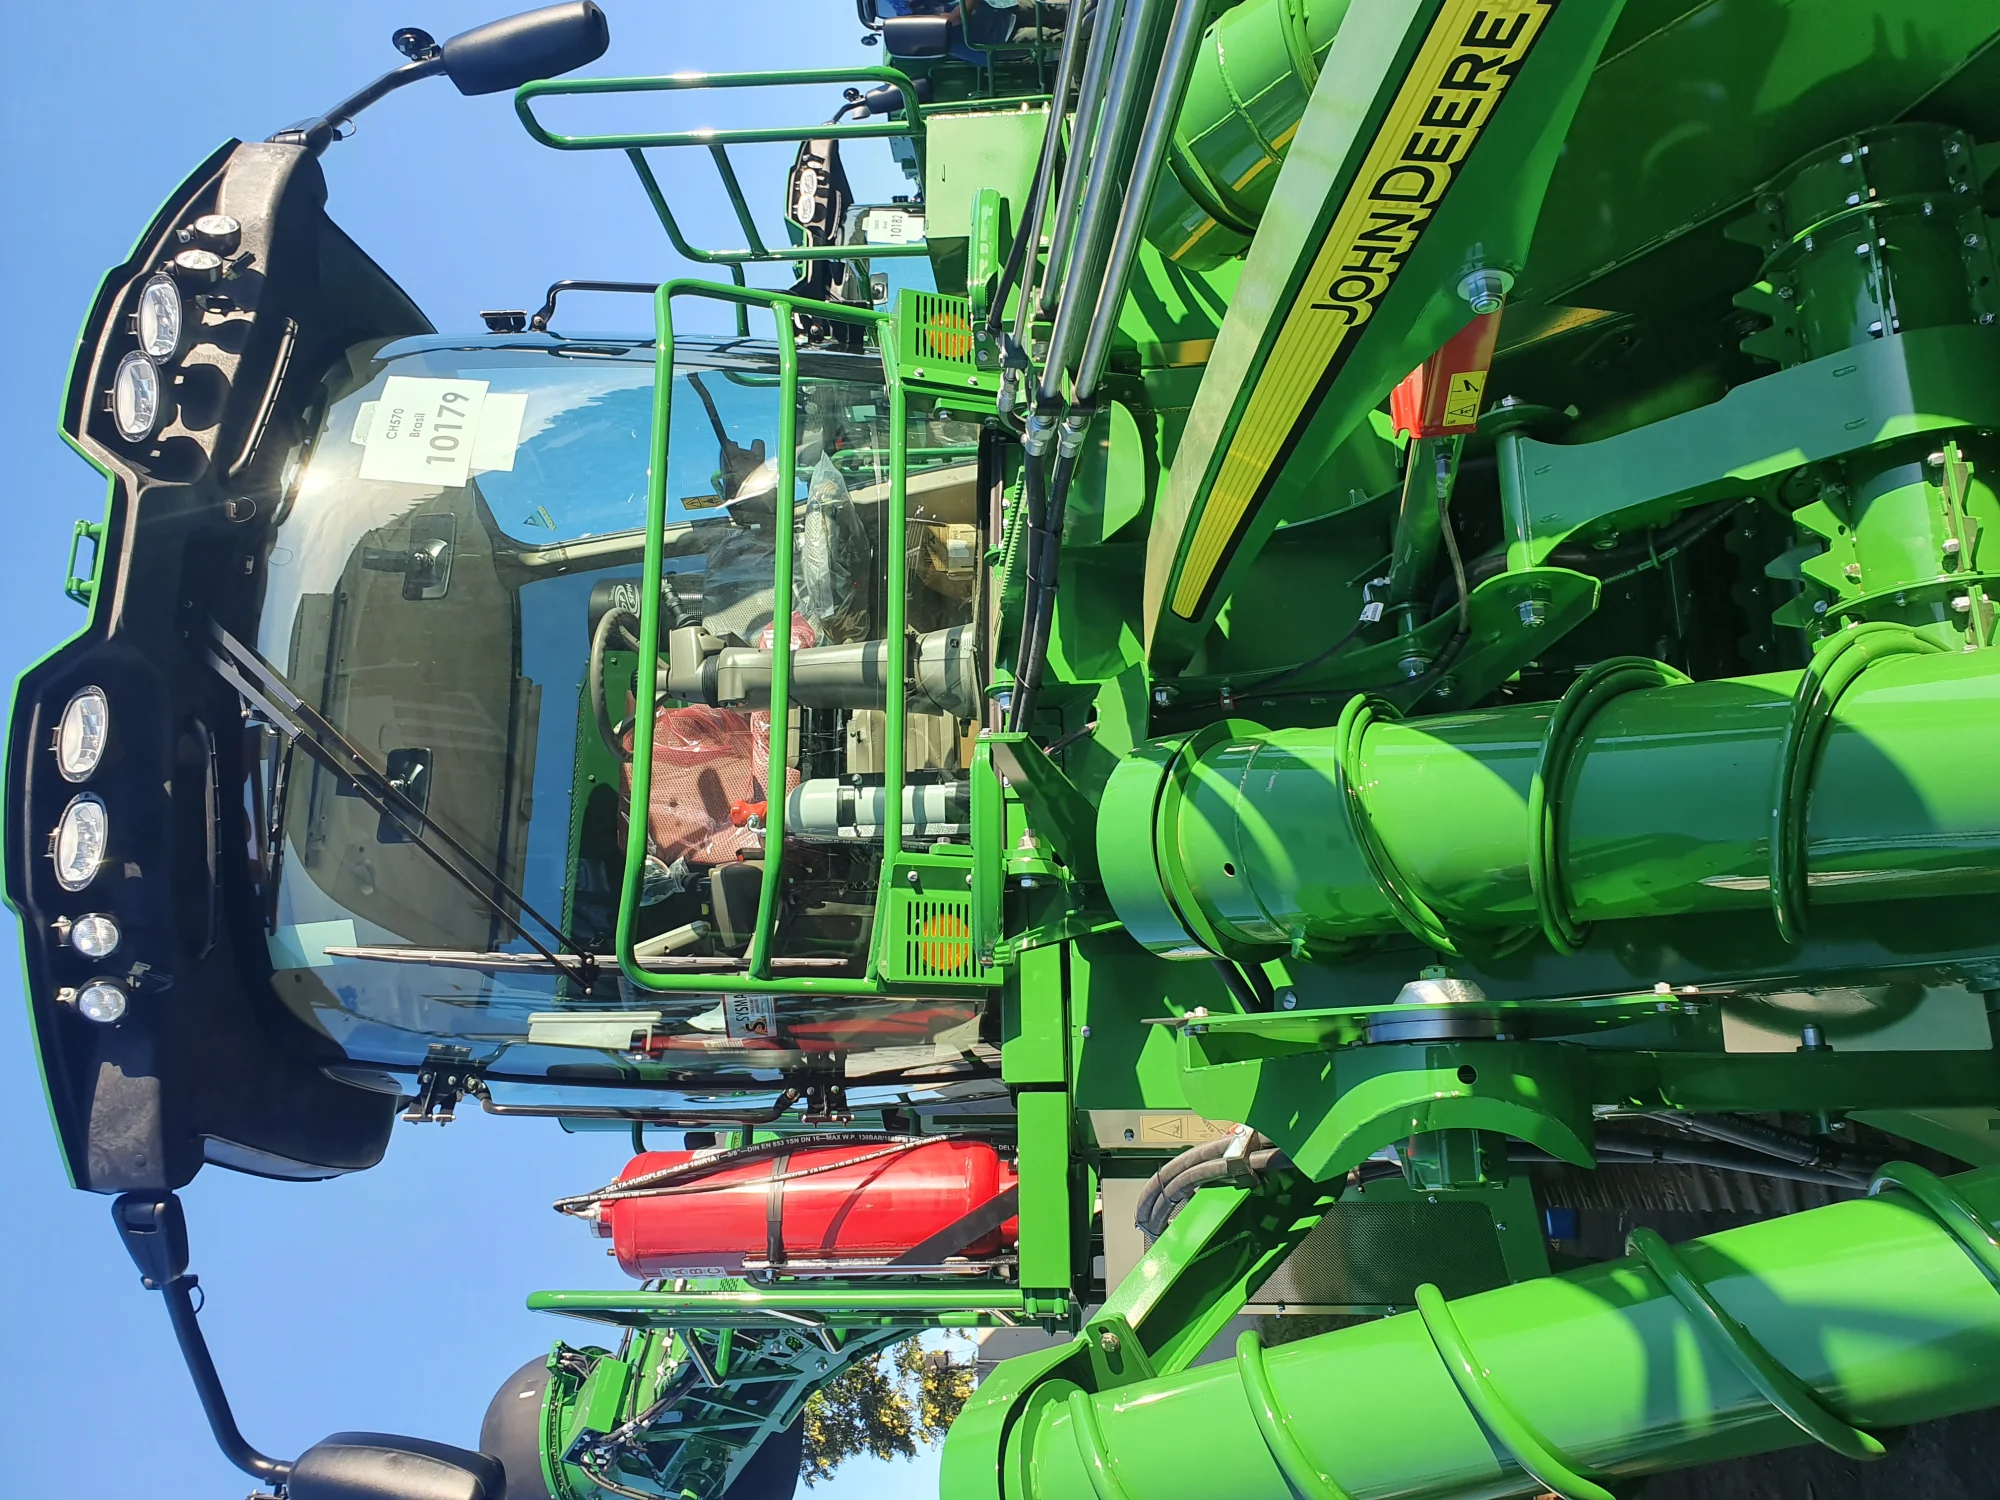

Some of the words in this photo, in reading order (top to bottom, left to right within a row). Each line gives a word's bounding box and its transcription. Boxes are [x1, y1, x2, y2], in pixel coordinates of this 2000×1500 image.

[1310, 211, 1416, 326] JOHN
[1367, 9, 1531, 204] DEERE
[890, 214, 903, 238] 10182
[386, 408, 405, 440] CH570
[409, 412, 426, 438] Brasil
[425, 392, 470, 465] 10179
[625, 583, 635, 604] SPIN
